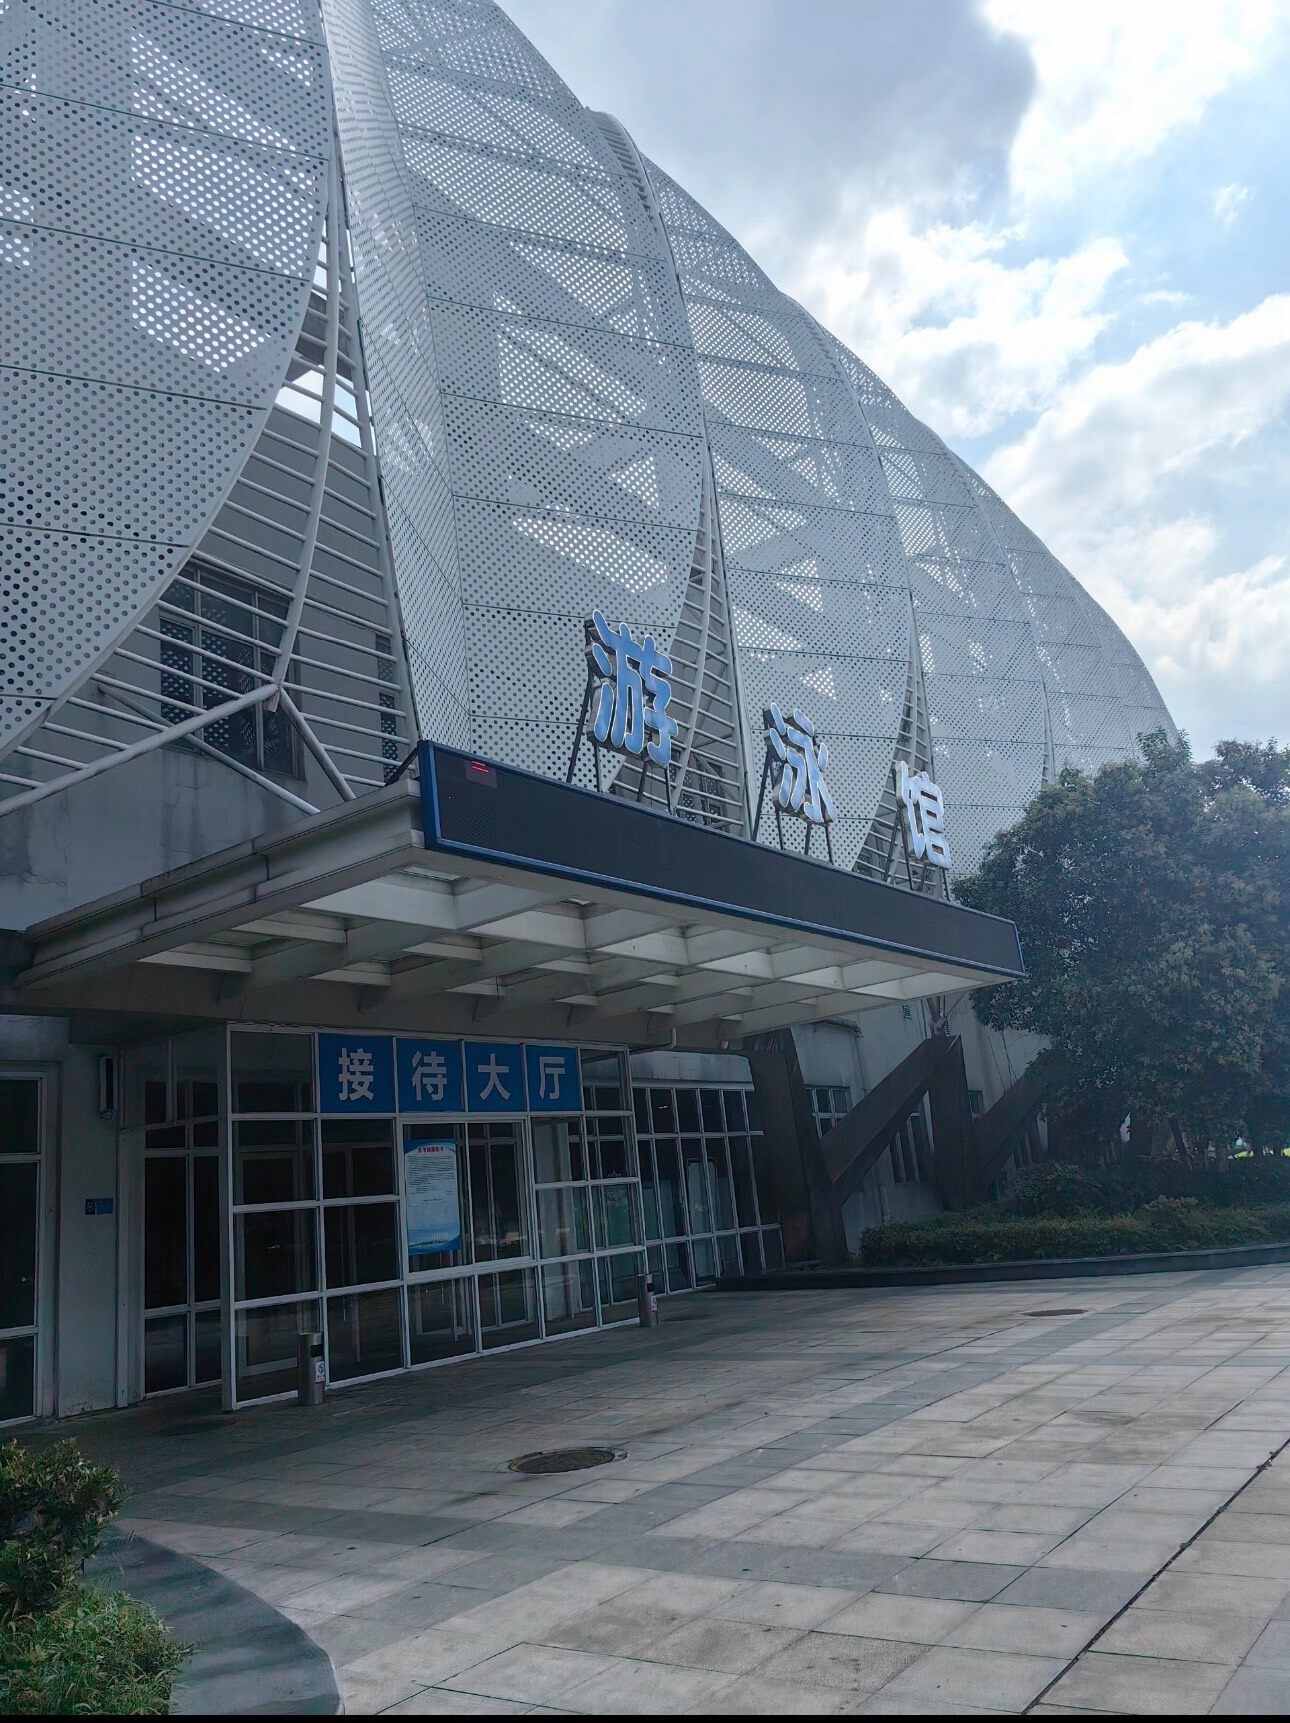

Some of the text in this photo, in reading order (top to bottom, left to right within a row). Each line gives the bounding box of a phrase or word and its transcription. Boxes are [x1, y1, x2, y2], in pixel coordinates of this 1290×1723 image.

[592, 609, 951, 869] 游泳馆
[338, 1048, 566, 1101] 接待大厅
